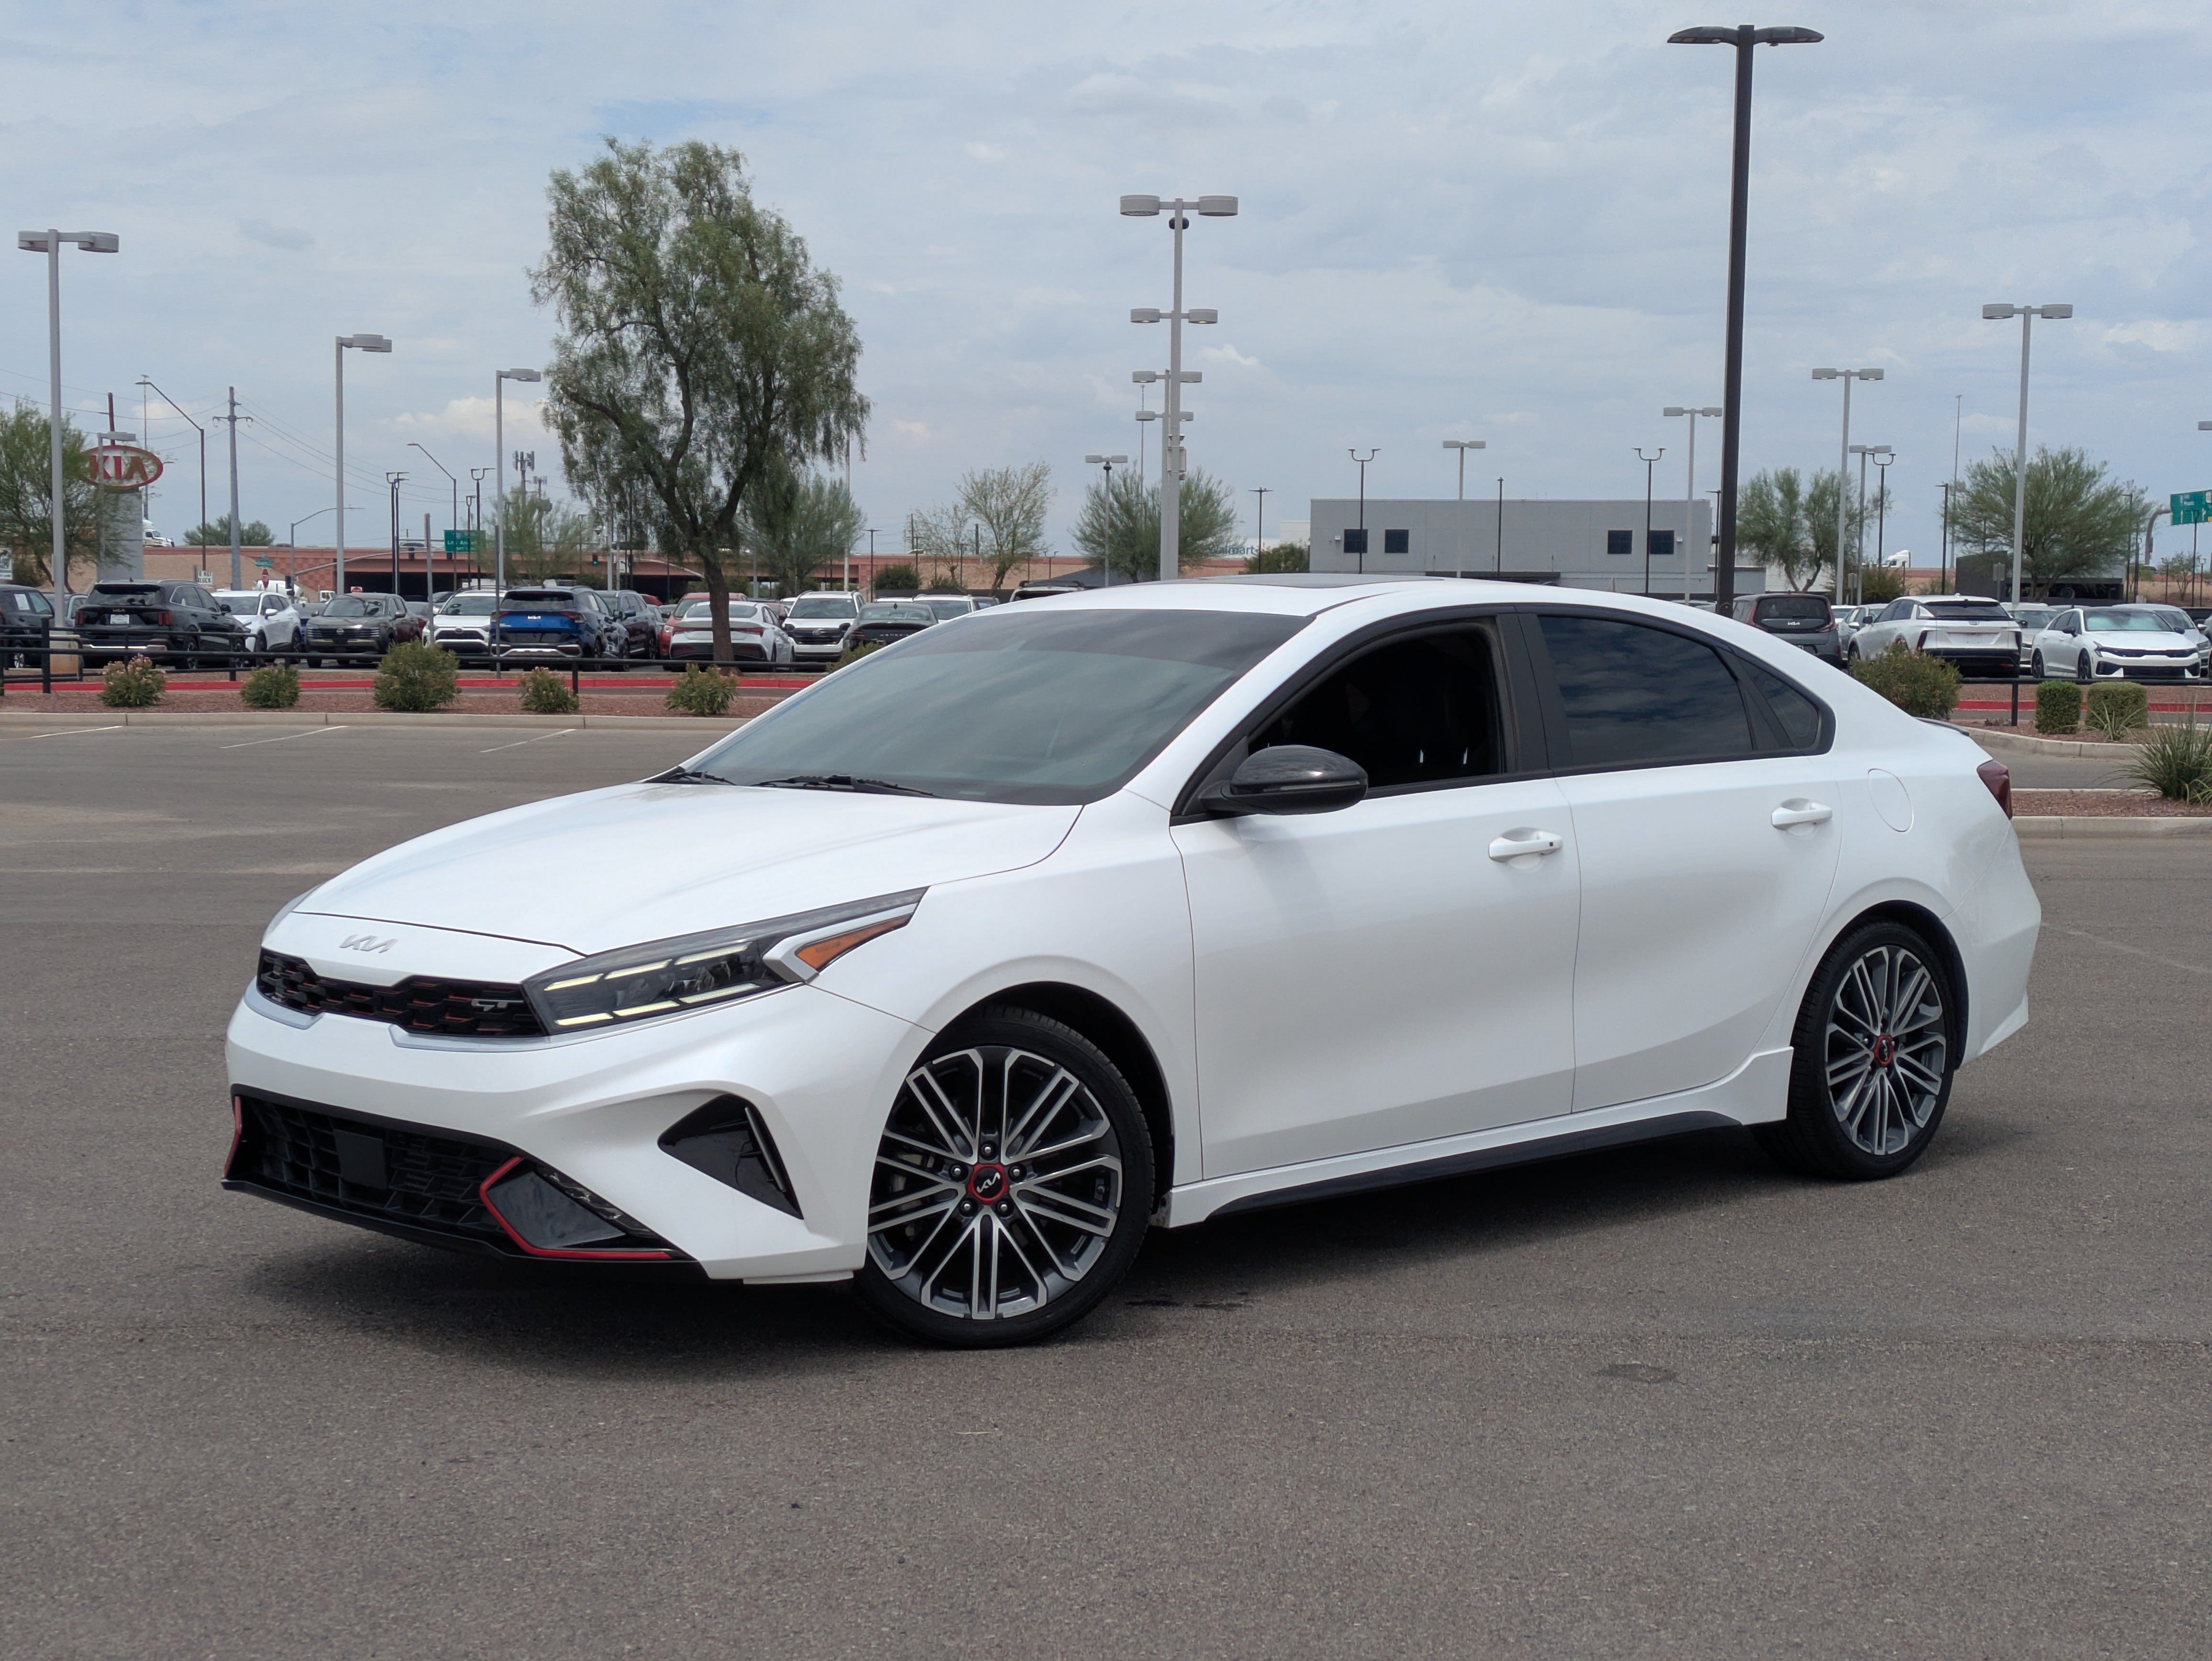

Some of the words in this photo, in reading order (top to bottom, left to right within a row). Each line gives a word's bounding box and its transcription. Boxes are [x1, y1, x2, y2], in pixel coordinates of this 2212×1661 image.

[89, 455, 148, 480] KIA
[339, 934, 398, 953] KIA
[471, 998, 524, 1012] GT
